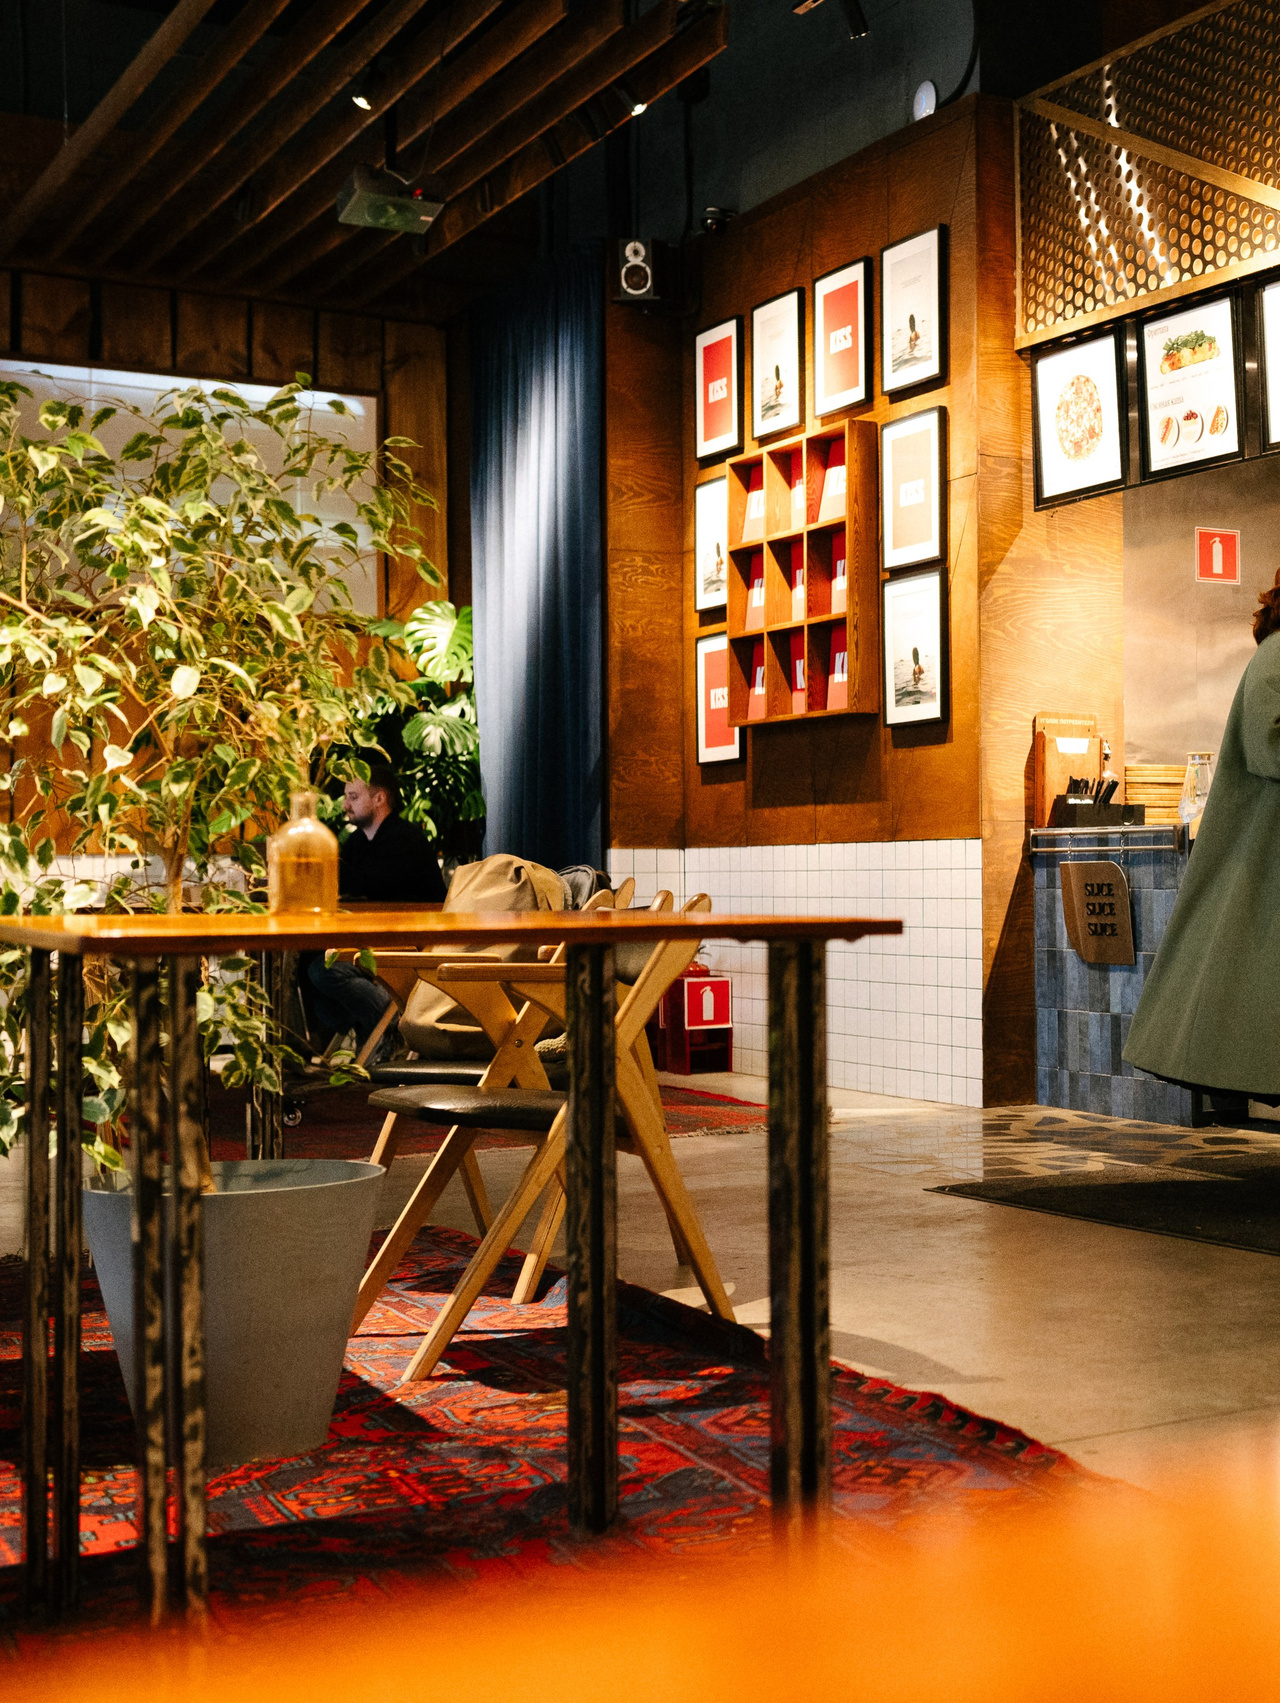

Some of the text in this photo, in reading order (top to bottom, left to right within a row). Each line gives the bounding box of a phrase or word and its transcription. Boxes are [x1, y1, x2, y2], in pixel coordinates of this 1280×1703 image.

[830, 325, 853, 355] KISS
[708, 377, 728, 404] KISS
[1084, 882, 1114, 896] SLICE
[1086, 902, 1116, 916] SLICE
[1088, 922, 1118, 937] SLICE
